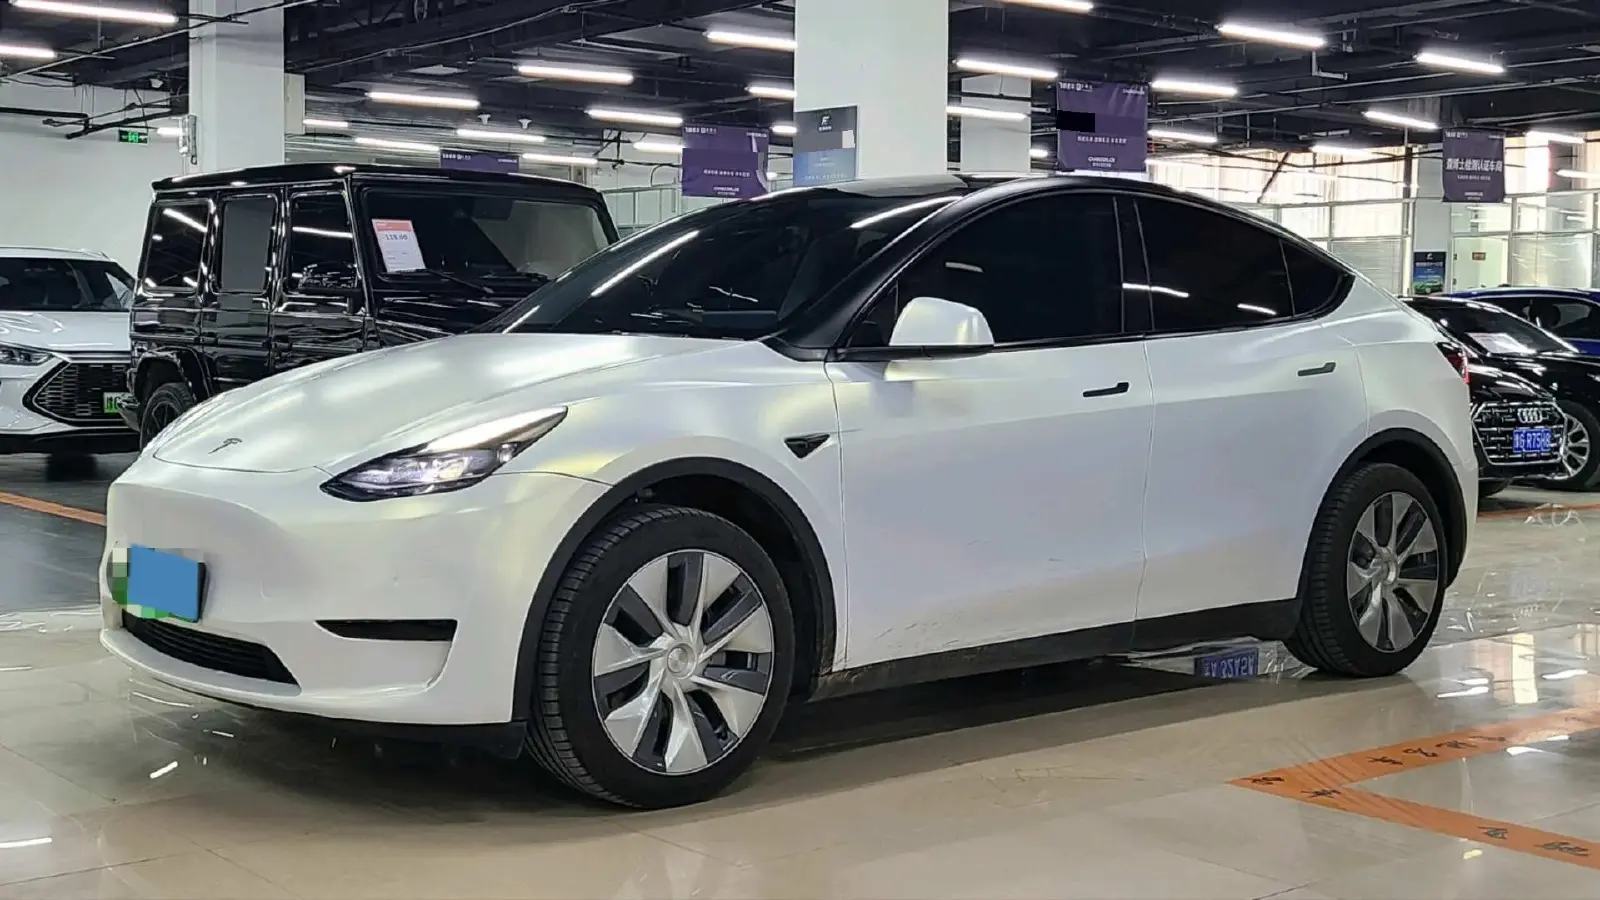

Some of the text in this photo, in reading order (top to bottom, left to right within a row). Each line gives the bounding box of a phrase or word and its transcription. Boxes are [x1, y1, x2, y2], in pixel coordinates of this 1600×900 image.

[1446, 158, 1503, 172] 查博士检测认证车商
